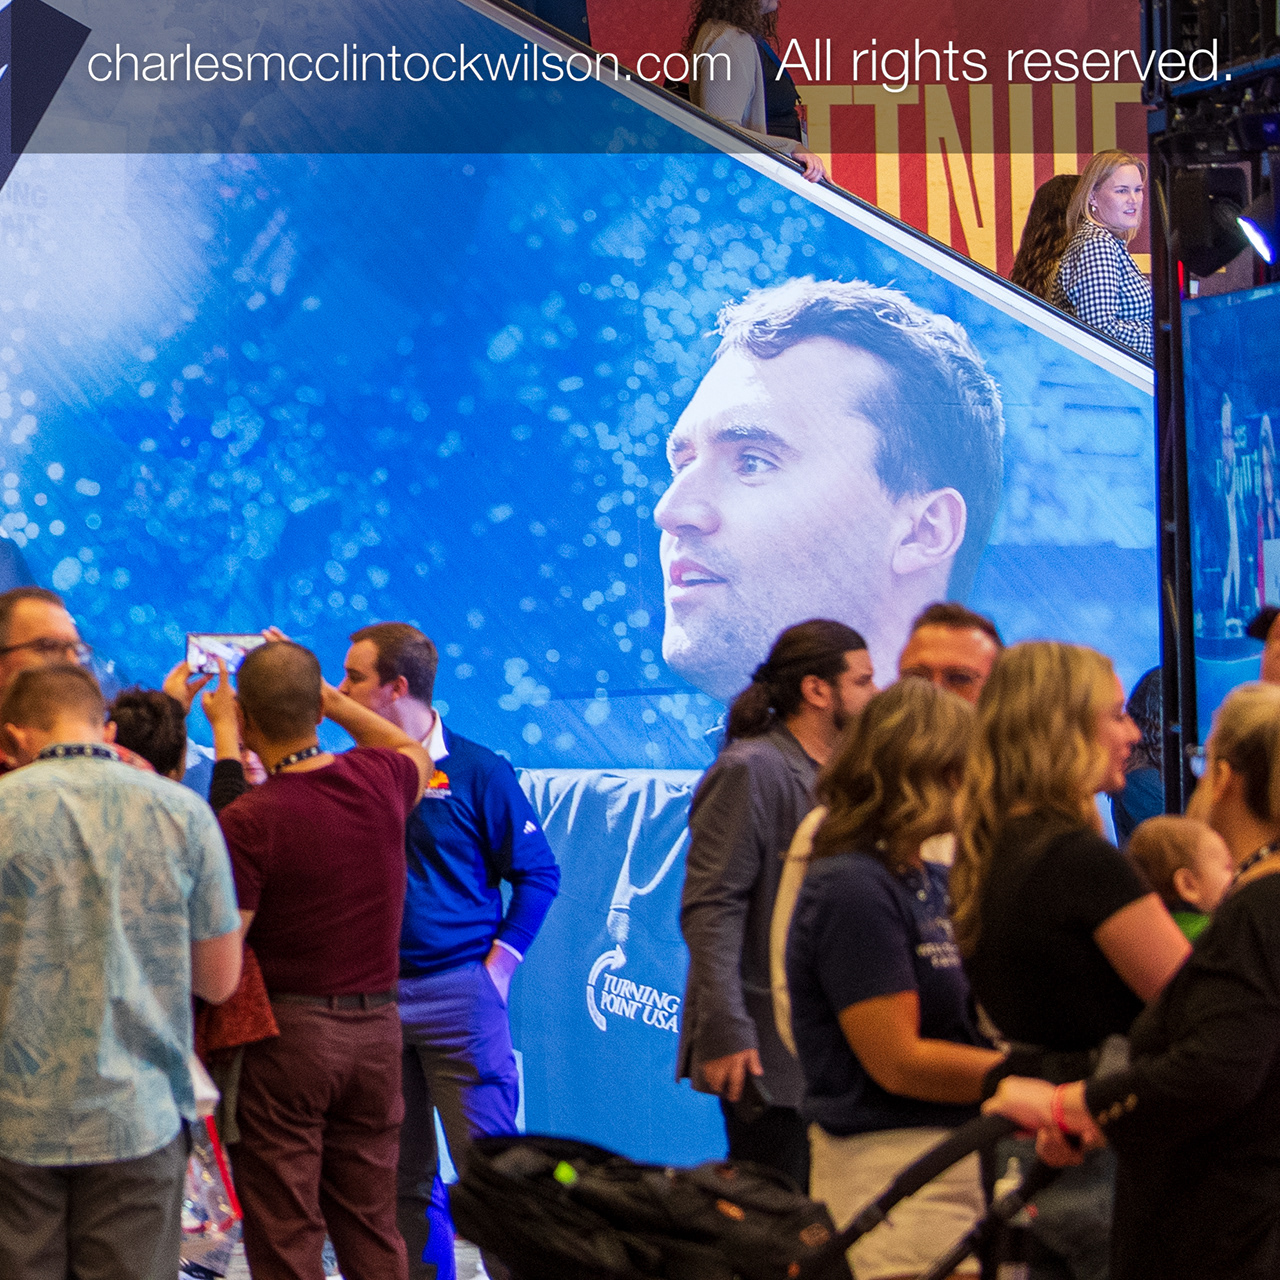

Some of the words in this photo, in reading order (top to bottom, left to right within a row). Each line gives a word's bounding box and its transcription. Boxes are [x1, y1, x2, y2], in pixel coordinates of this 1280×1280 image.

[600, 990, 643, 1020] POINT
[642, 1005, 680, 1034] USA
[603, 972, 682, 1014] TURNING
